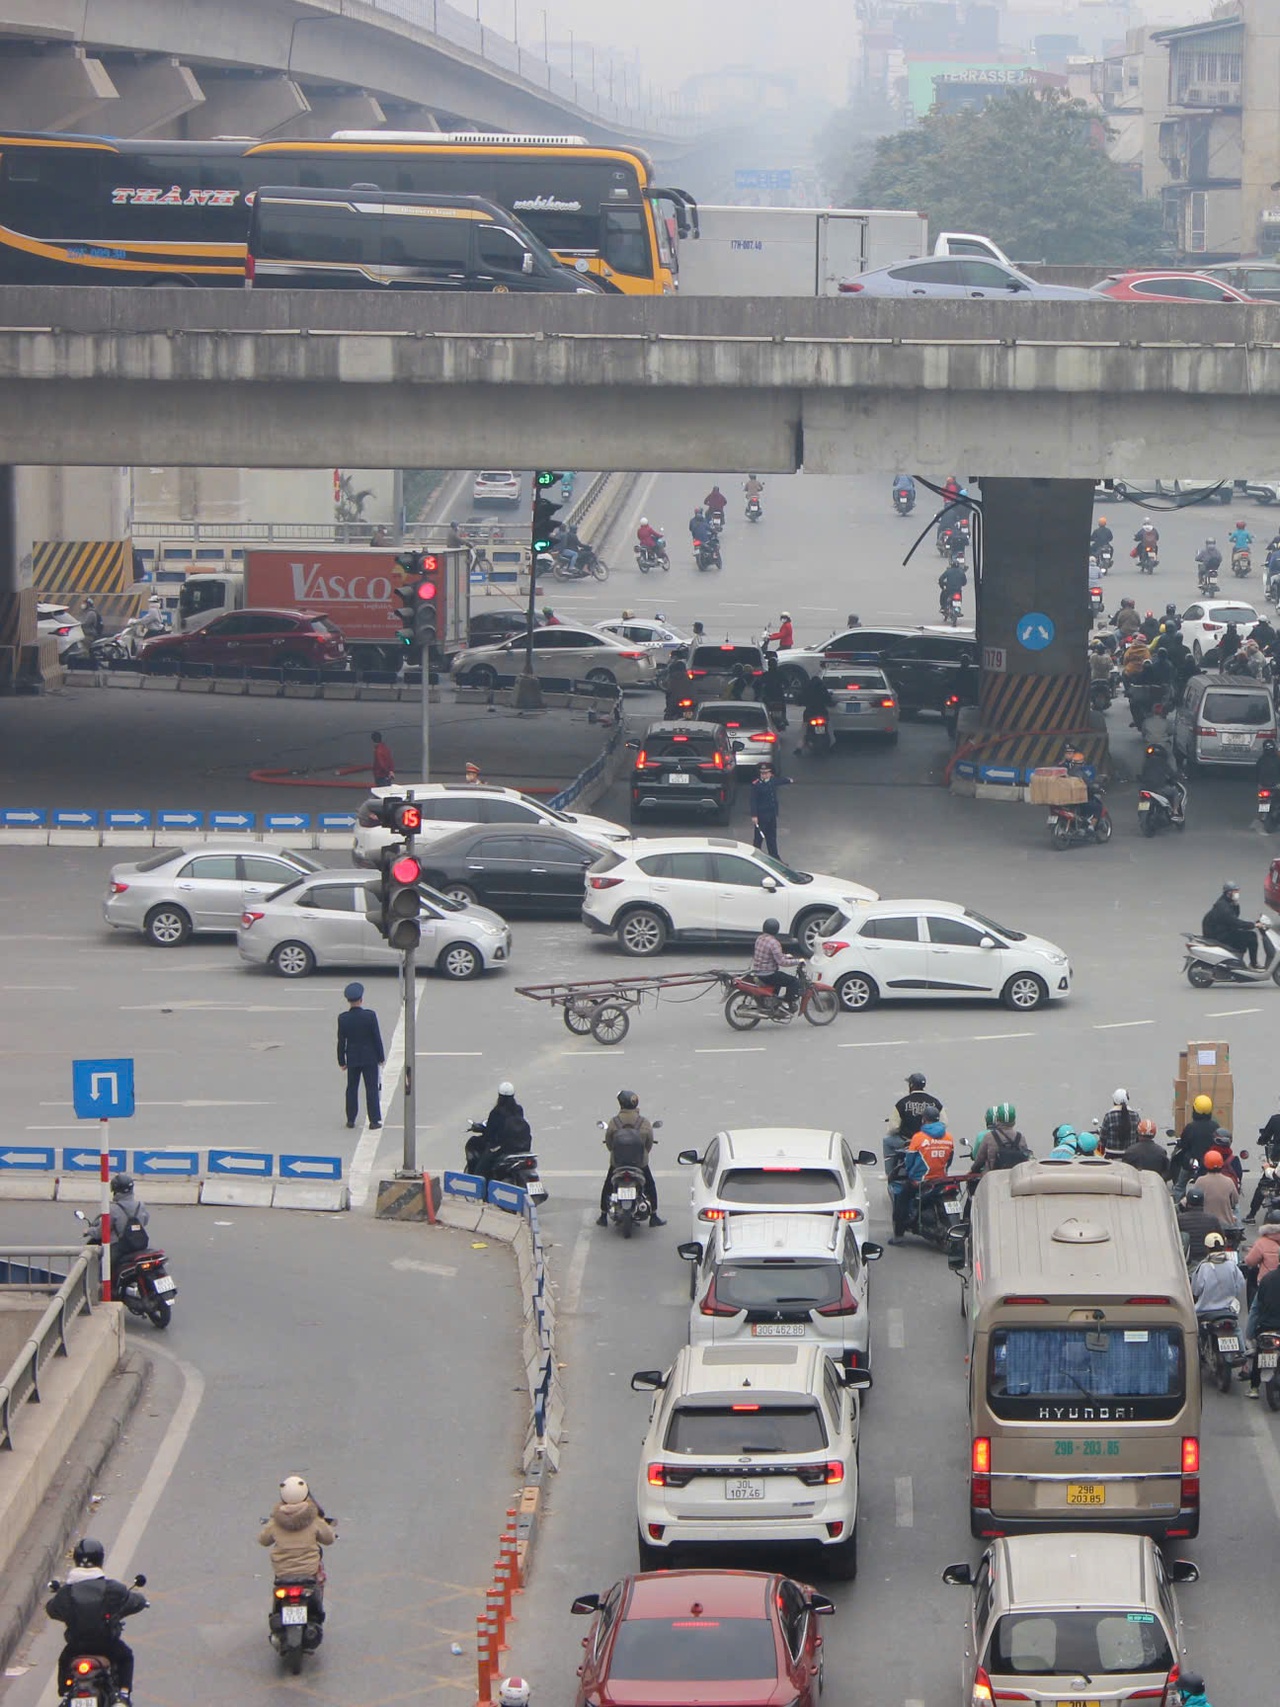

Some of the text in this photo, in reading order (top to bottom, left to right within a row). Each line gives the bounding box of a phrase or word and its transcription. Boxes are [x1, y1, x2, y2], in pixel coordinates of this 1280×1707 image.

[513, 195, 582, 211] mobihome
[403, 810, 419, 827] 15
[1039, 1408, 1134, 1419] HYUNDAI
[737, 1481, 754, 1489] 30L
[1078, 1486, 1094, 1494] 29B
[731, 1489, 760, 1498] 107.46
